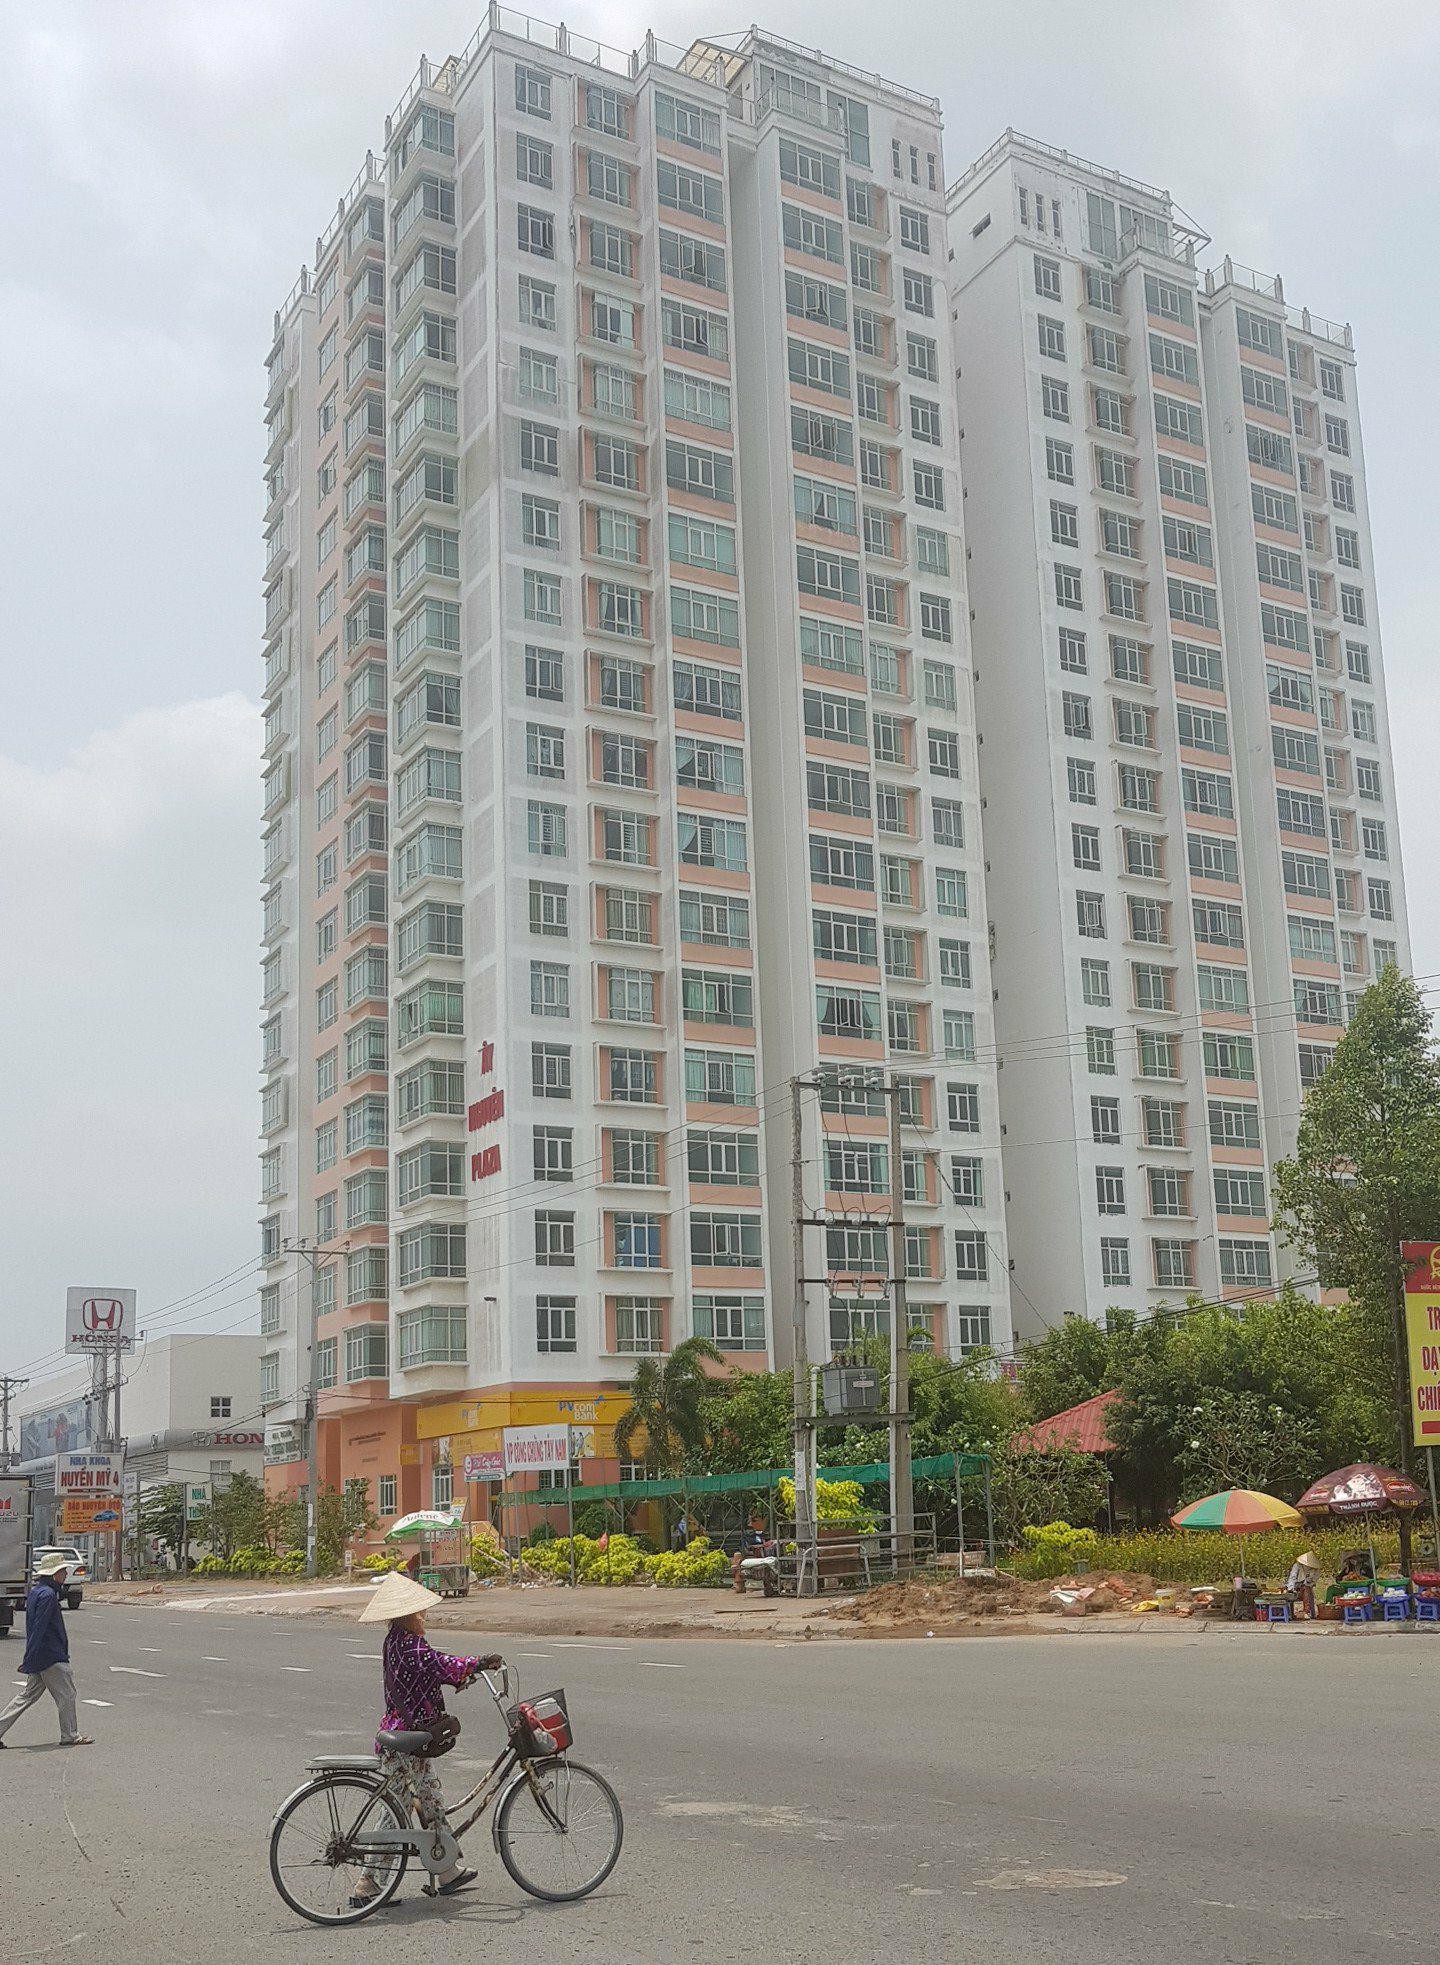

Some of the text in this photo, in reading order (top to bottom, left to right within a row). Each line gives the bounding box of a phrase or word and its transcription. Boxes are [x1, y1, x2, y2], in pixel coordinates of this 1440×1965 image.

[471, 1143, 502, 1182] PLAZA
[574, 1410, 599, 1421] Bank
[113, 1471, 119, 1486] 4
